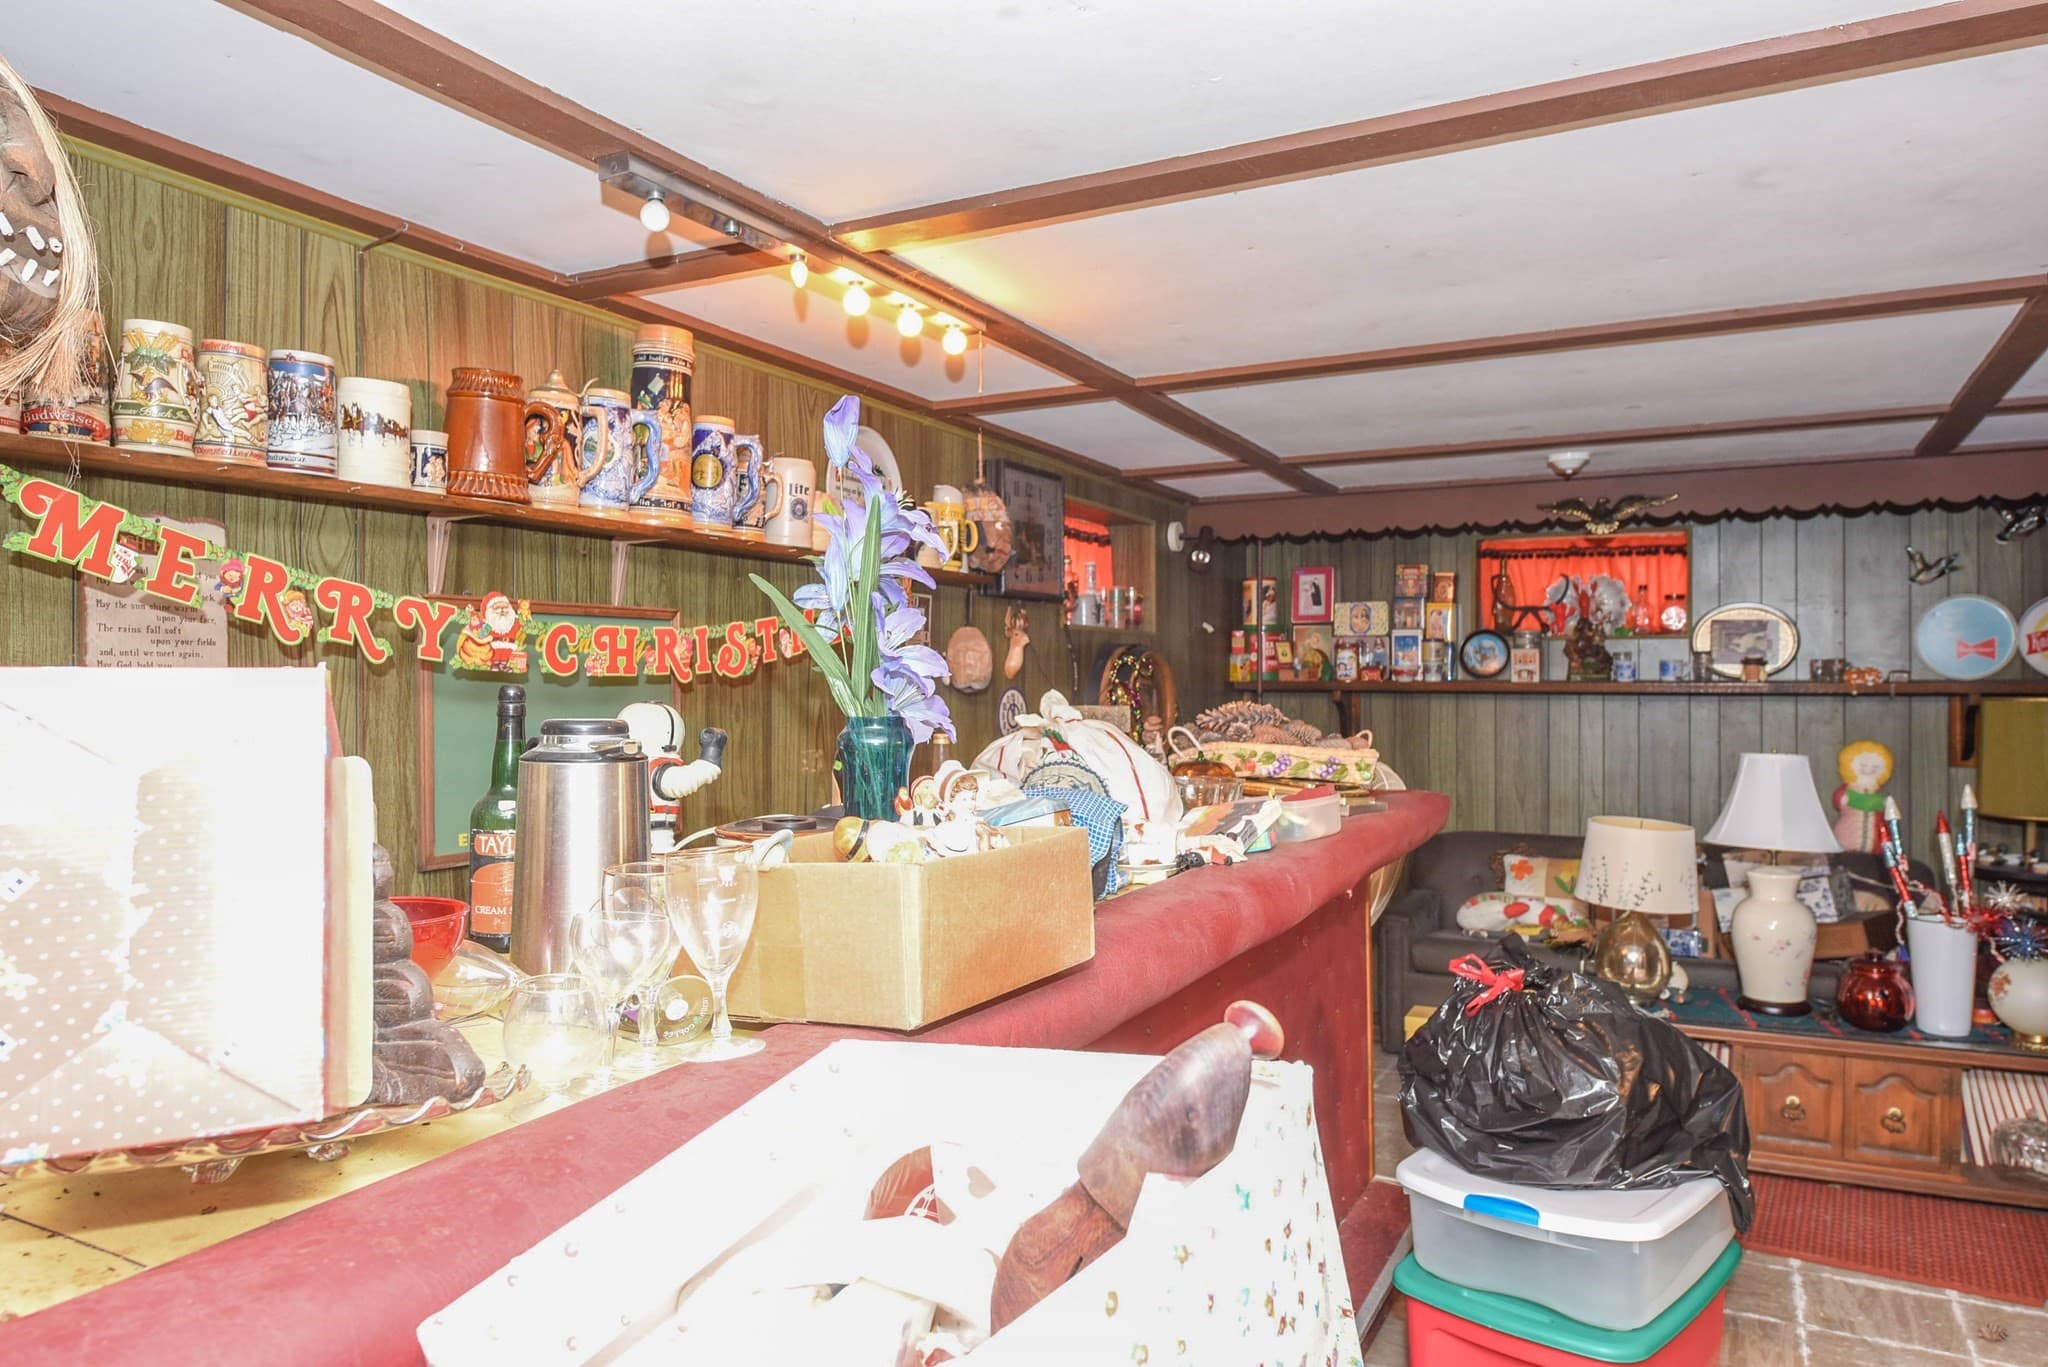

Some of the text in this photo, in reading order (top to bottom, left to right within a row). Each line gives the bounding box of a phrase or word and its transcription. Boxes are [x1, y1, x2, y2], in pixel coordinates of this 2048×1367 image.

[789, 483, 810, 497] Lite
[18, 479, 853, 684] MERRY CHRIST
[96, 599, 110, 609] May
[115, 599, 127, 608] the
[150, 603, 171, 612] shine
[180, 616, 196, 624] your
[97, 623, 181, 634] The rains fall soft
[150, 637, 216, 647] upon your fields
[120, 648, 139, 656] until
[479, 836, 515, 855] TAYL
[475, 905, 507, 915] CREAM
